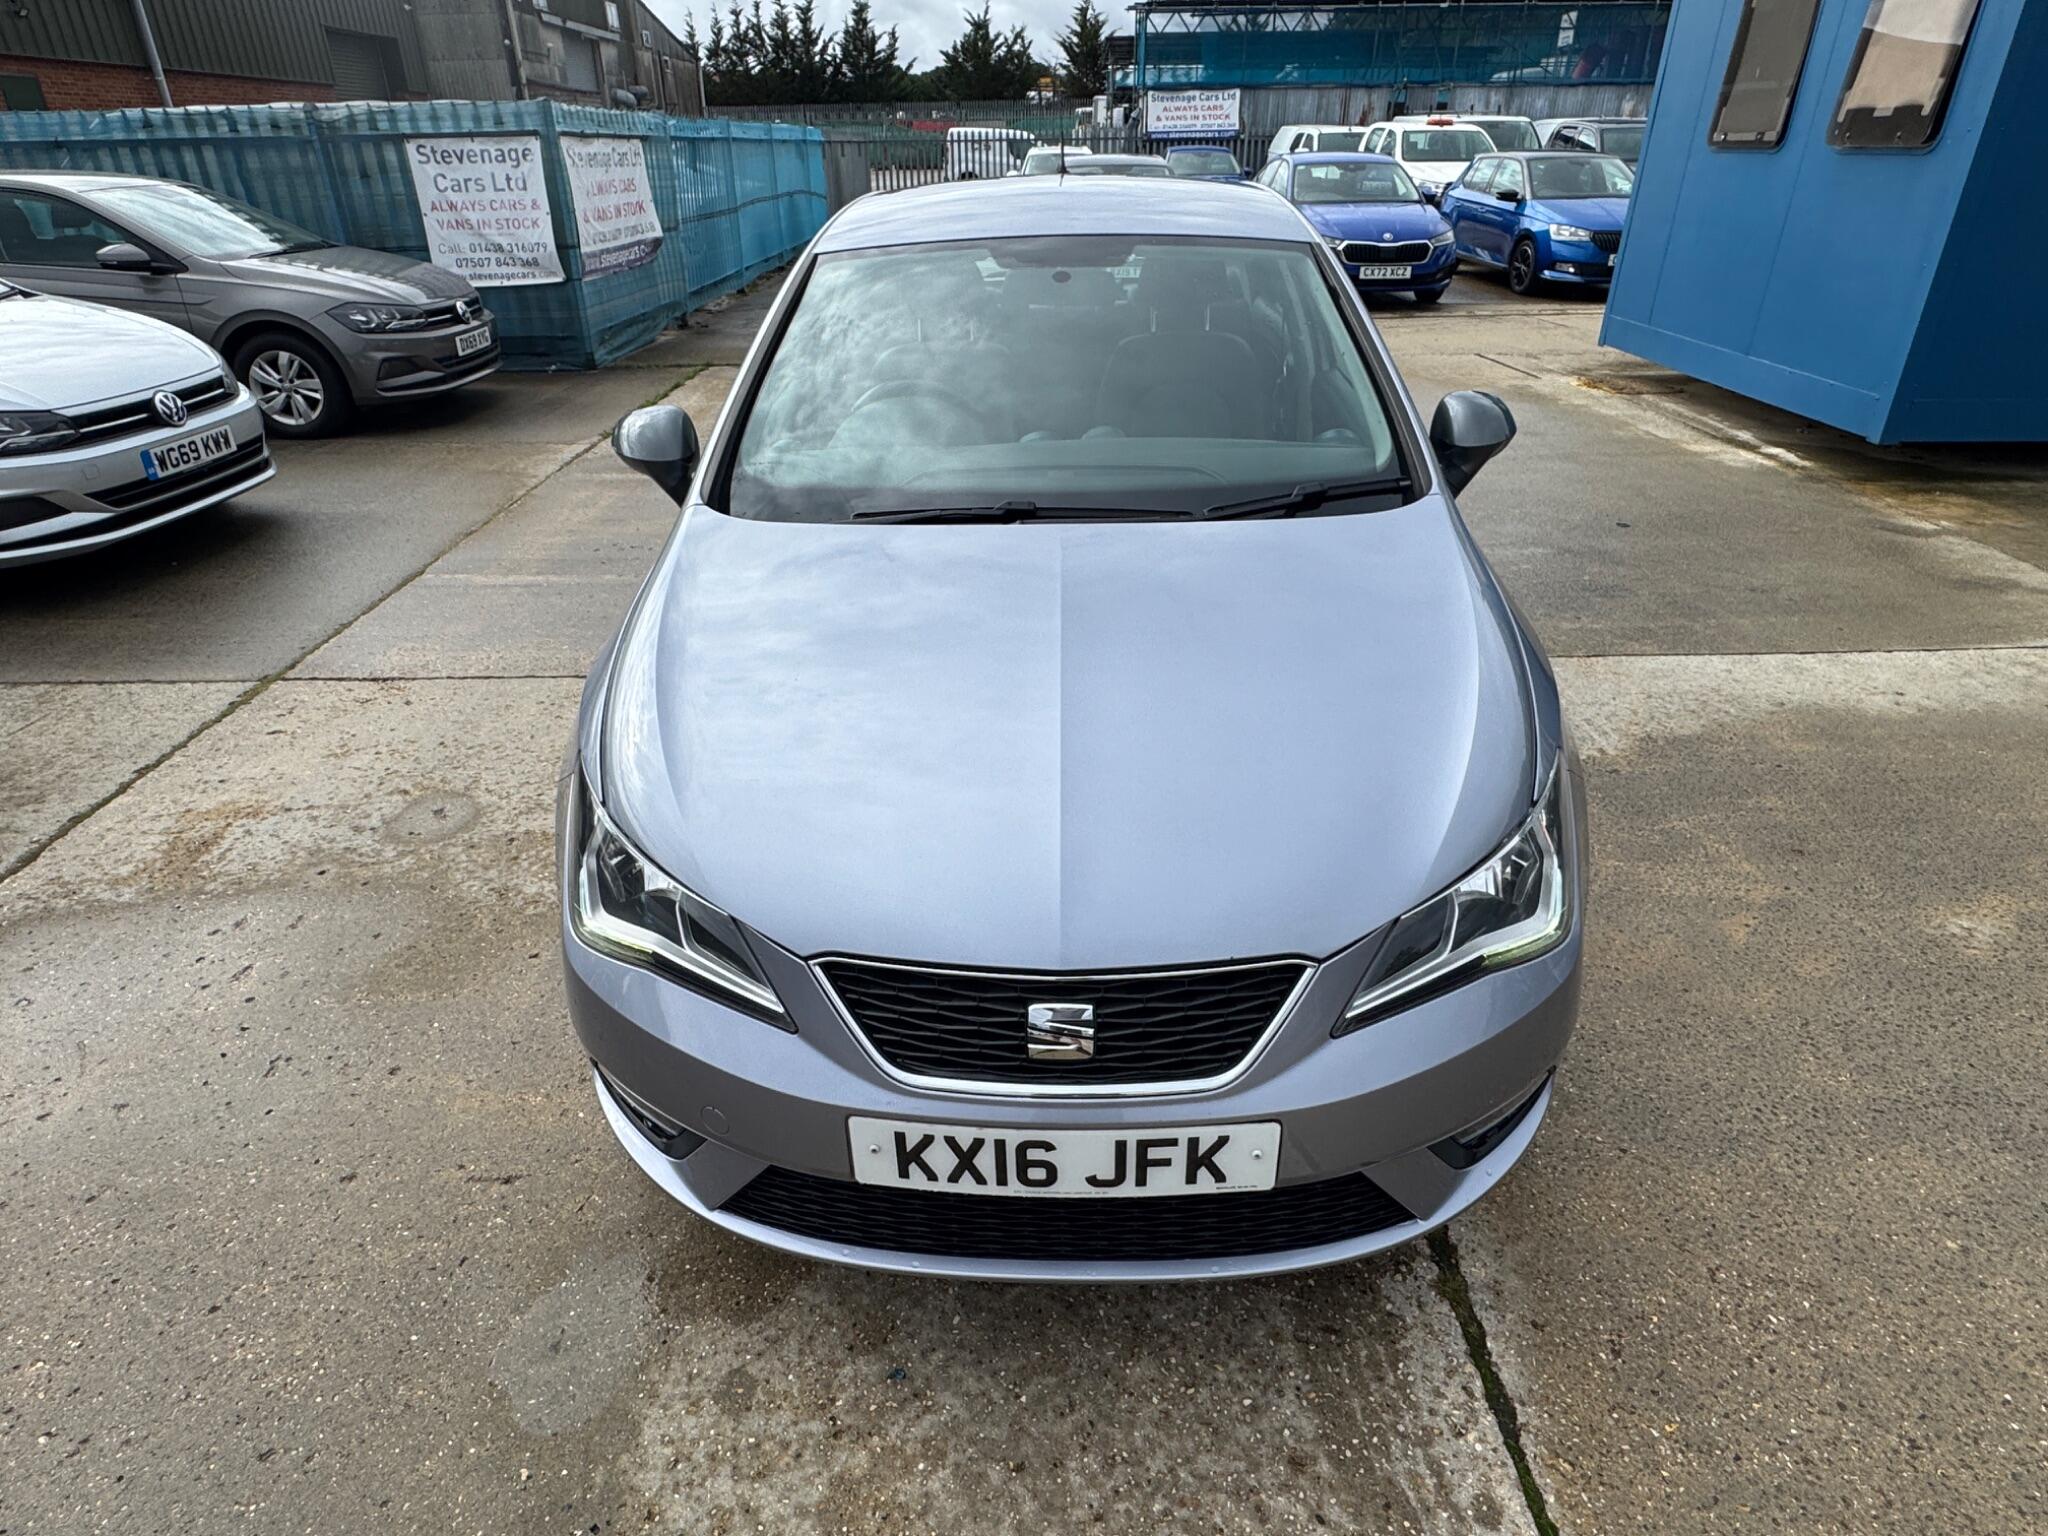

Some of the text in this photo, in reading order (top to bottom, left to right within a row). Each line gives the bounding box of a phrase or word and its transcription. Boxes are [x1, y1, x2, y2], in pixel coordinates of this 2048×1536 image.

[1151, 91, 1237, 104] Stevenage Cars Ltd
[1162, 104, 1224, 113] ALWAYS CARS
[1165, 114, 1188, 122] VANS
[1201, 113, 1231, 121] STOCK
[416, 144, 534, 169] Stevenage
[433, 170, 529, 193] Cars Ltd
[431, 199, 541, 213] ALWAYS CARS &
[437, 217, 541, 231] VANS IN STOCK
[469, 242, 505, 254] 01438
[507, 242, 548, 254] 316079
[455, 257, 491, 269] 07507
[495, 257, 517, 267] 843
[1363, 267, 1408, 277] CX72 XCZ
[153, 439, 202, 473] WG69
[893, 1130, 1231, 1189] KX16 JFK
